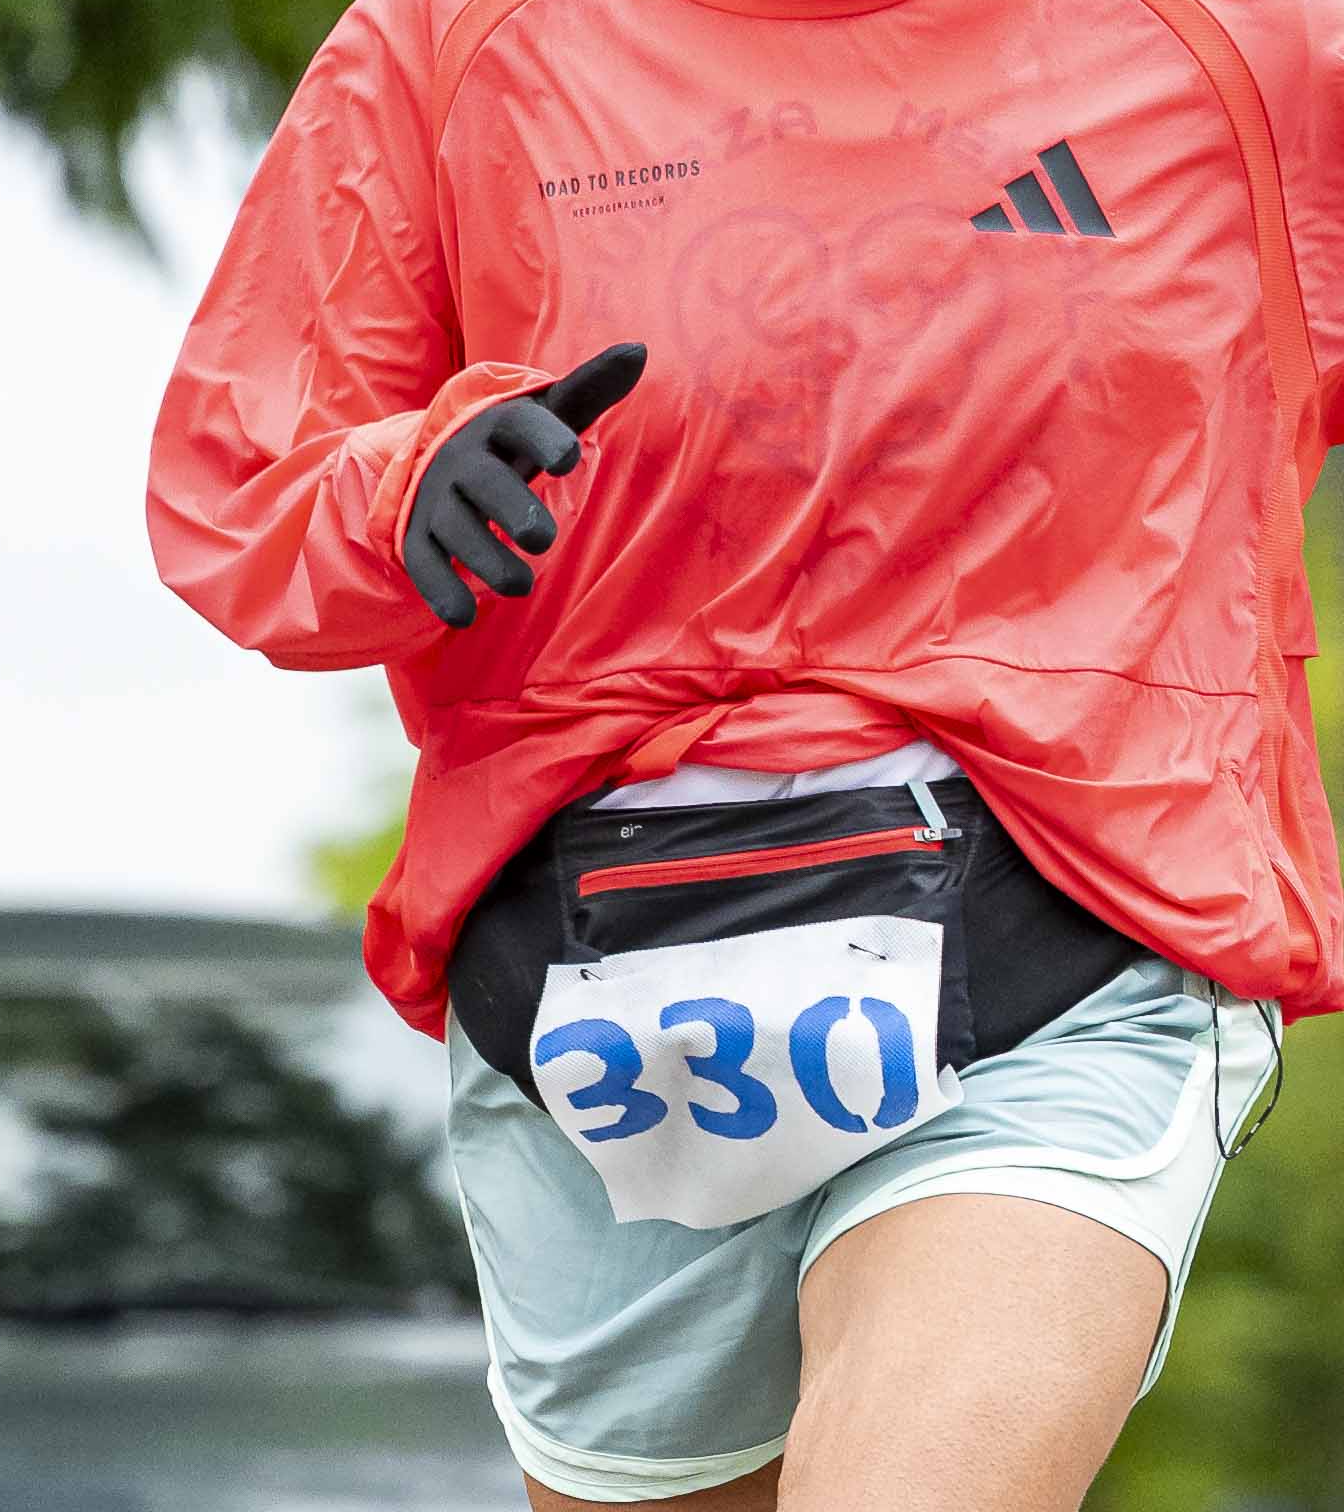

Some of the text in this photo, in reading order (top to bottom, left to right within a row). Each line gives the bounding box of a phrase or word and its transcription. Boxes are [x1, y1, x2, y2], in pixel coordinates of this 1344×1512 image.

[588, 173, 608, 191] TO
[616, 160, 700, 186] RECORDS
[535, 996, 919, 1143] 330
